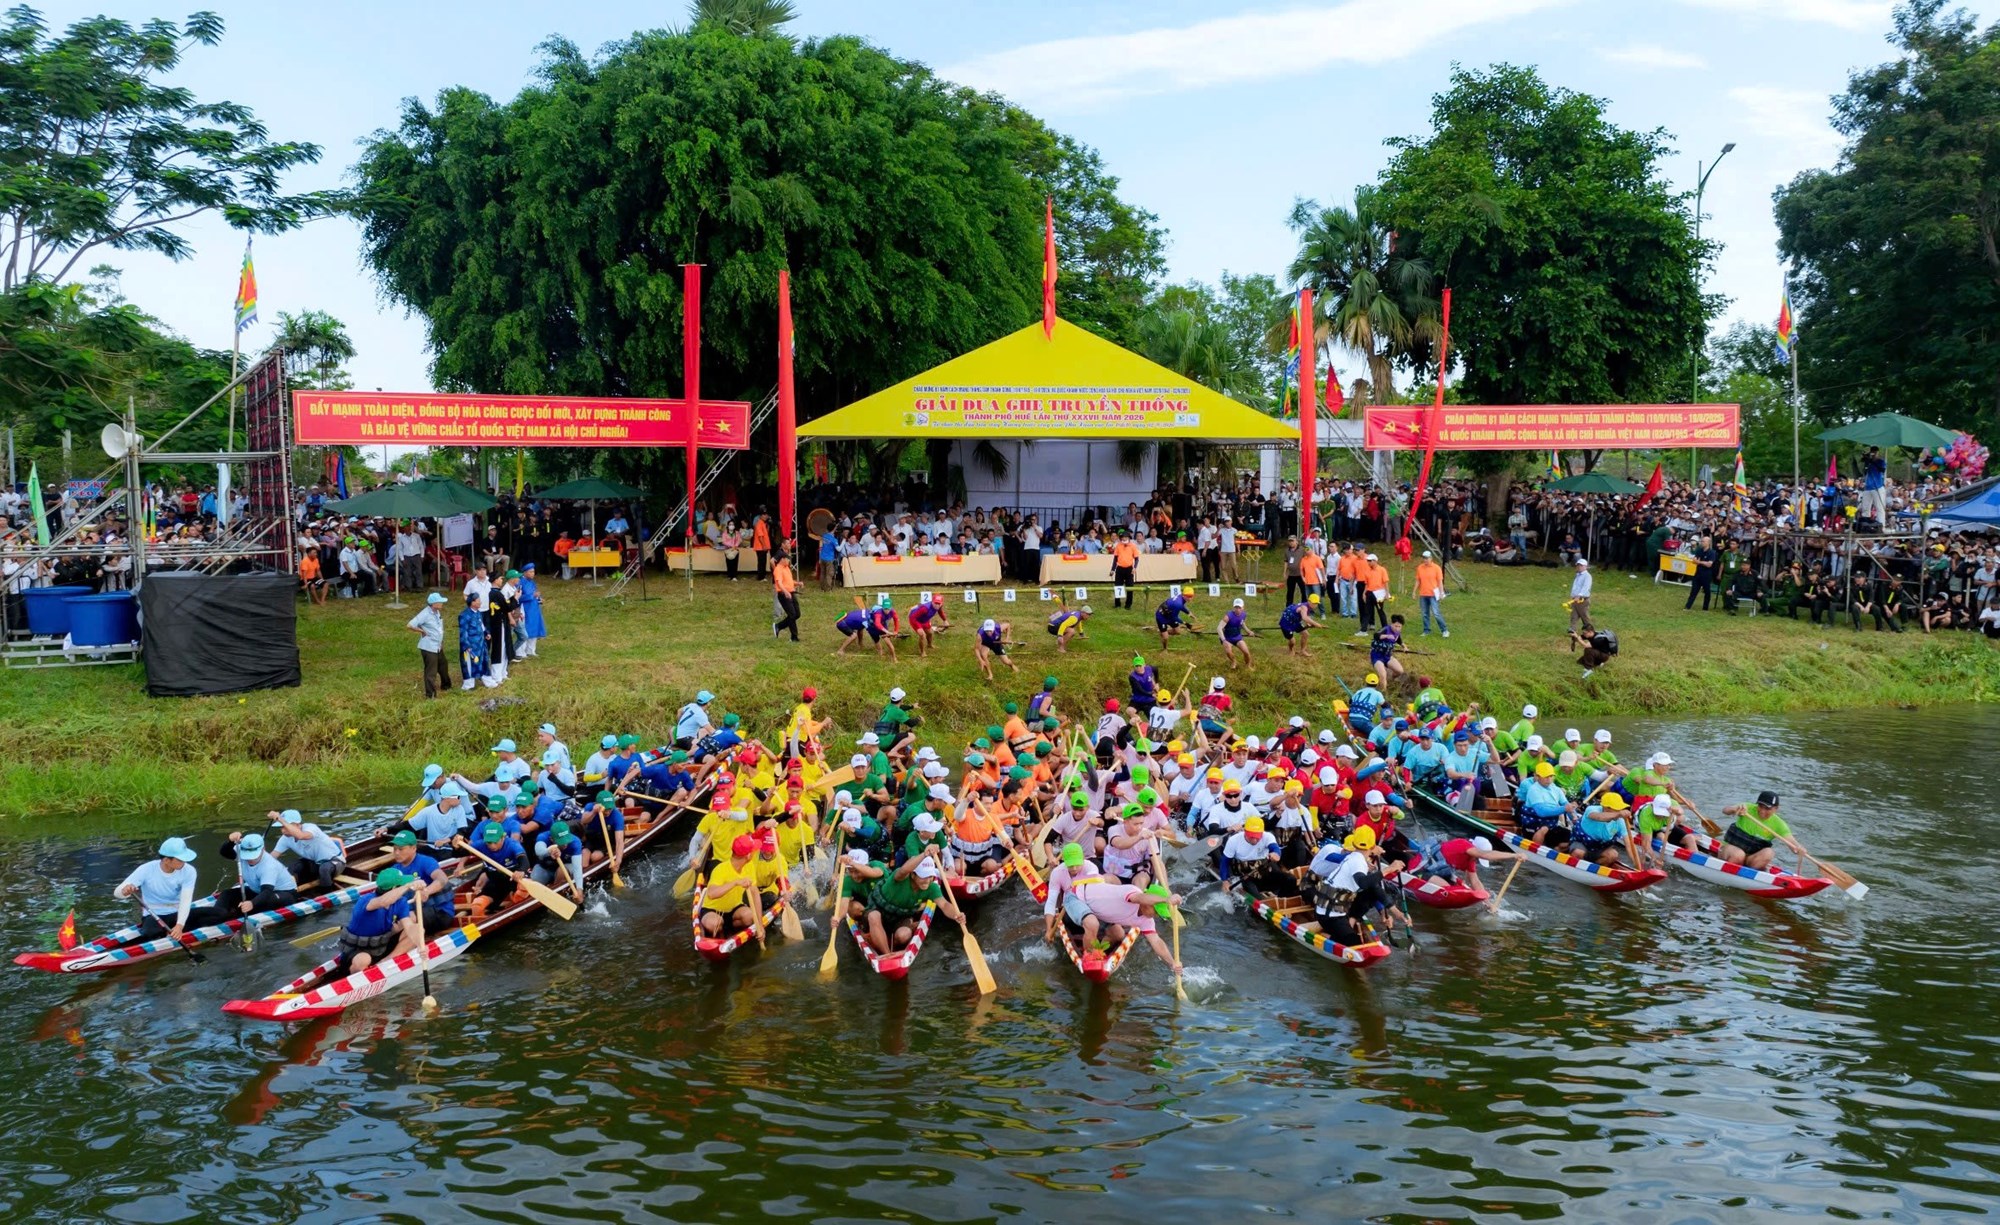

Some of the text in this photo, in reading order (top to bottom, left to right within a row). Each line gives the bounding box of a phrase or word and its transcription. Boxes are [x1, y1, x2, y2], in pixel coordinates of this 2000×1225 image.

[915, 394, 957, 411] GIẢI
[1006, 399, 1043, 411] GHE
[1048, 394, 1122, 411] TRUYỀN
[1127, 395, 1188, 411] THỐNG
[310, 399, 330, 416] ĐẨY
[332, 403, 362, 418] MẠNH
[364, 401, 390, 417] TOÀN
[392, 402, 417, 419] DIỆN,
[419, 402, 445, 417] ĐỒNG
[447, 404, 461, 420] BỘ
[483, 404, 508, 418] CÔNG
[510, 405, 535, 421] CUỘC
[536, 404, 551, 419] ĐỔI
[553, 406, 573, 421] MỚI,
[575, 406, 592, 420] XÂY
[594, 408, 618, 422] DỰNG
[619, 407, 647, 421] THÀNH
[648, 408, 671, 421] CÔNG
[995, 412, 1012, 420] PHỐ
[1014, 412, 1031, 420] HUẾ
[1034, 412, 1050, 420] LẦN
[1053, 412, 1069, 420] THỨ
[1445, 413, 1464, 425] CHÀO
[1466, 412, 1488, 425] MỪNG
[1489, 414, 1497, 425] 81
[1499, 412, 1516, 425] NĂM
[1517, 412, 1536, 424] CÁCH
[1537, 414, 1559, 426] MẠNG
[1560, 412, 1584, 424] THÁNG
[1585, 411, 1601, 424] TÁM
[1601, 411, 1625, 423] THÀNH
[1625, 411, 1646, 423] CÔNG
[361, 420, 629, 440] VÀ BẢO VỆ VỮNG CHẮC TỔ QUỐC VIỆT NAM XÃ HỘI CHỦ NGHĨA!
[1439, 429, 1449, 441] VÀ
[1450, 427, 1470, 441] QUỐC
[1471, 428, 1495, 440] KHÁNH
[1497, 428, 1516, 441] NƯỚC
[1517, 428, 1538, 442] CỘNG
[1554, 427, 1565, 440] XÃ
[1565, 427, 1578, 441] HỘI
[1579, 426, 1594, 440] CHỦ
[1595, 427, 1617, 440] NGHĨA
[1617, 427, 1633, 441] VIỆT
[1634, 429, 1651, 440] NAM
[1043, 590, 1049, 598] 5
[1079, 589, 1084, 597] 6
[1117, 587, 1123, 596] 7
[1173, 588, 1179, 596] 8
[1212, 585, 1217, 594] 9
[1248, 586, 1256, 594] 10
[923, 593, 929, 602] 2
[967, 592, 973, 600] 3
[1007, 591, 1013, 599] 4
[1150, 712, 1166, 729] 12
